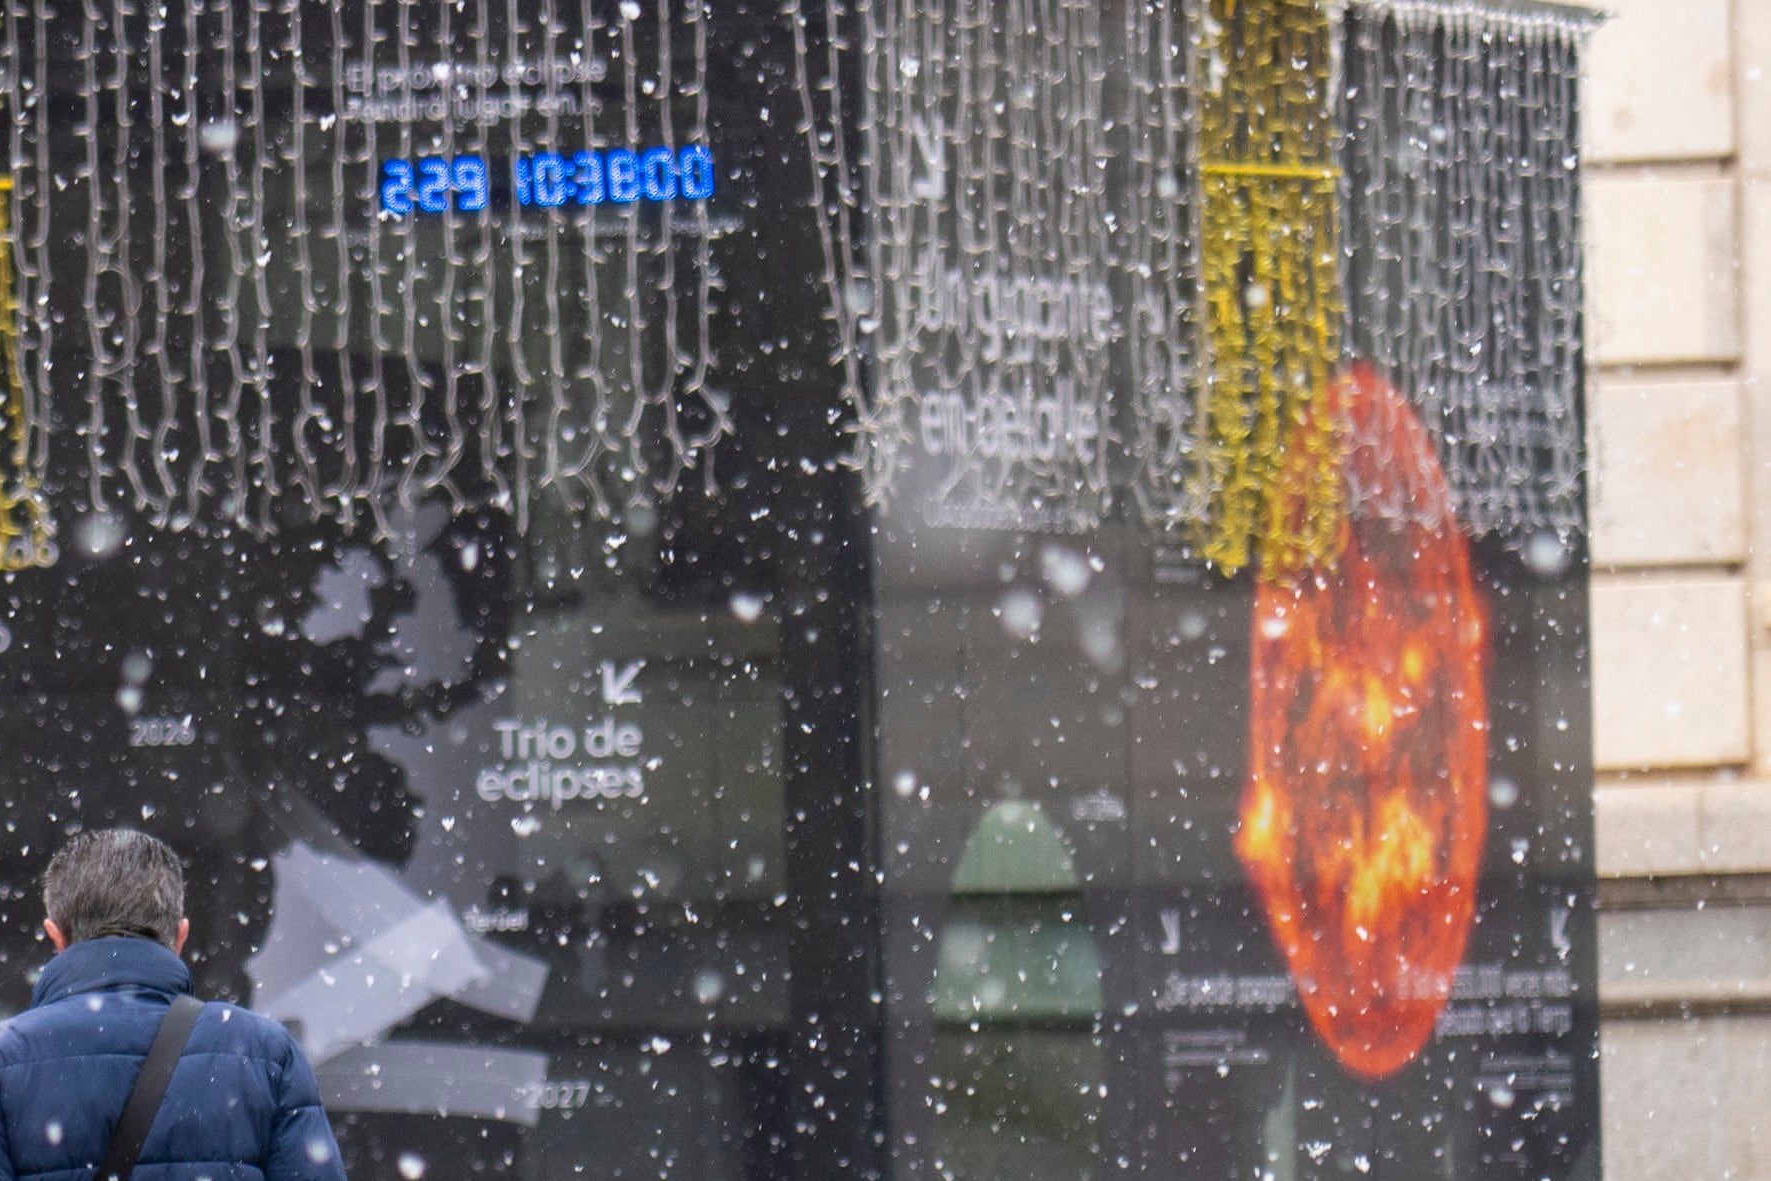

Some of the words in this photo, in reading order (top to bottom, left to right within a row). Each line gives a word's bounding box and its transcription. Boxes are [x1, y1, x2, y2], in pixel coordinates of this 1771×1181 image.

[380, 157, 490, 215] 229
[130, 719, 196, 747] 2026
[492, 717, 576, 760] Trio
[584, 714, 643, 758] de
[476, 759, 644, 811] eclipses
[528, 1082, 590, 1109] 2027
